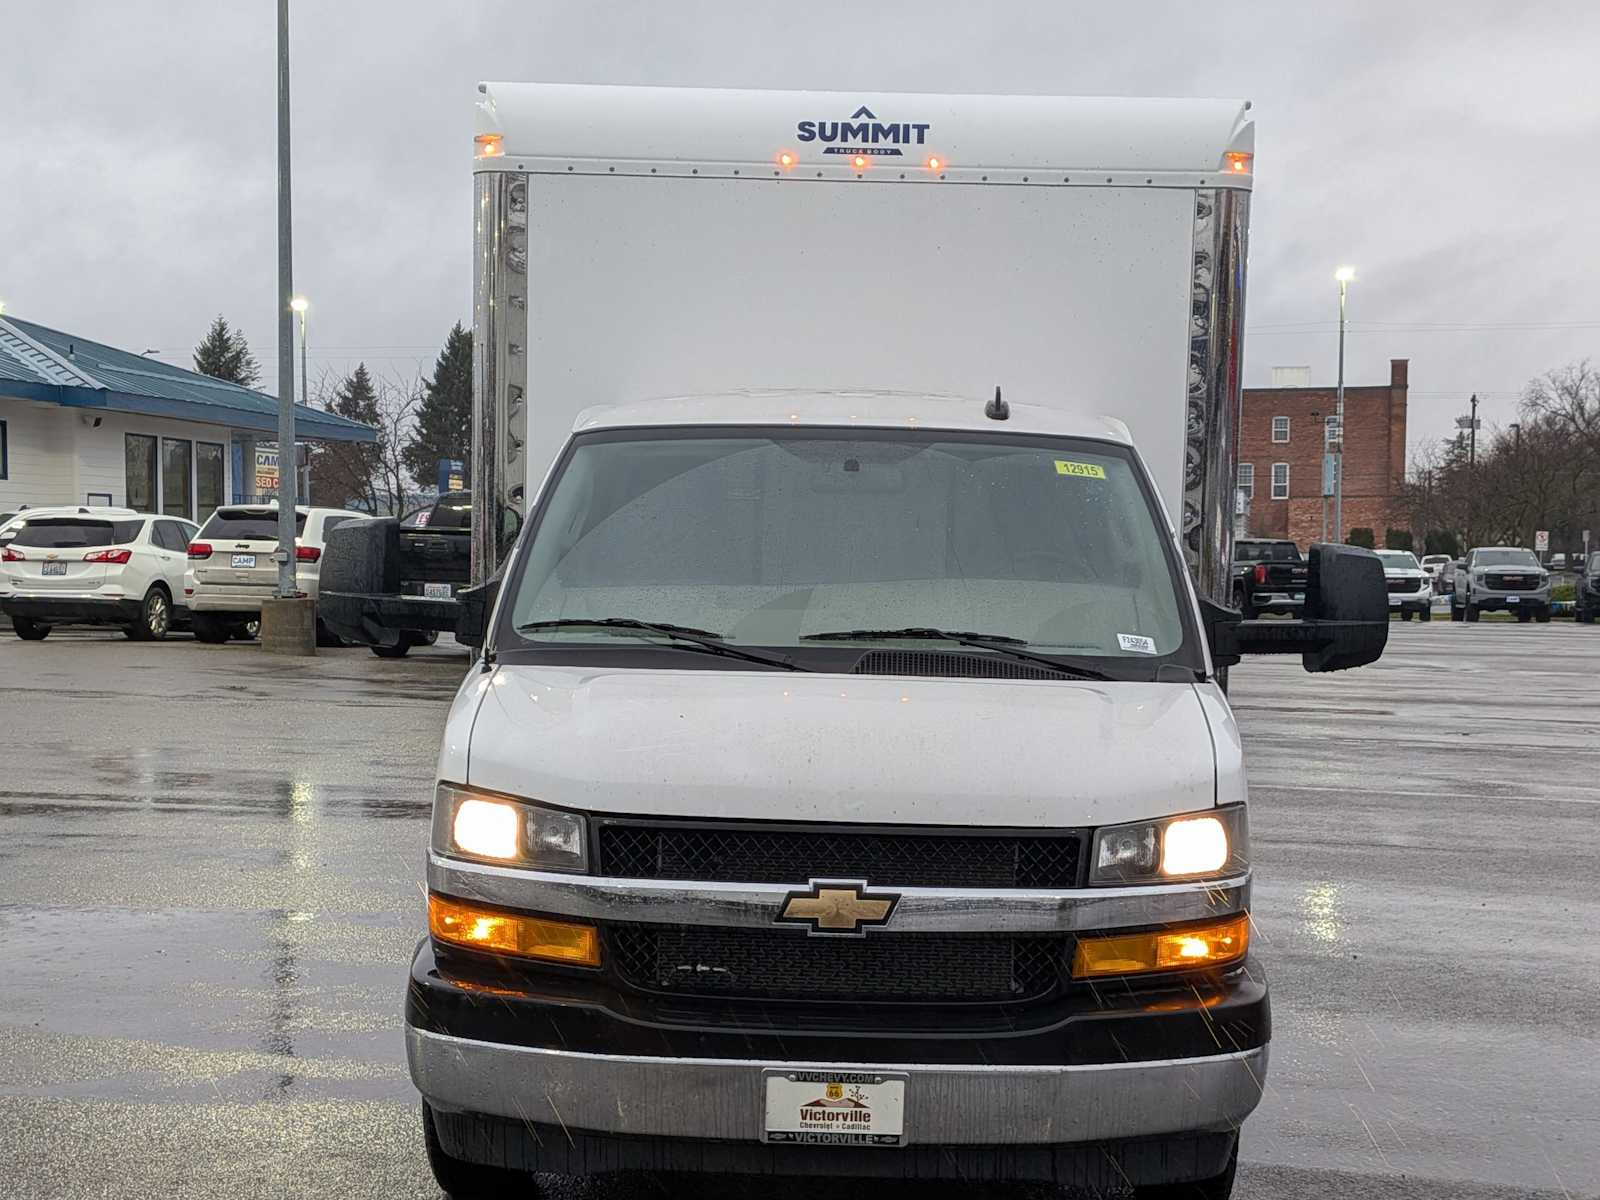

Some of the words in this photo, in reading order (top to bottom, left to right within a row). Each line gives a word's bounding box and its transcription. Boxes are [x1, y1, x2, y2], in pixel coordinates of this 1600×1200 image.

[797, 121, 930, 144] SUMMIT
[256, 454, 280, 466] CAM
[1063, 463, 1098, 476] 12915
[256, 476, 271, 488] SED
[232, 556, 254, 565] CAMP
[799, 1072, 873, 1083] VVCHEVY.COM
[800, 1108, 871, 1122] Victorville
[800, 1121, 833, 1130] Chevrolet
[841, 1123, 871, 1131] Cadillac
[795, 1132, 873, 1144] VICTORVILLE
